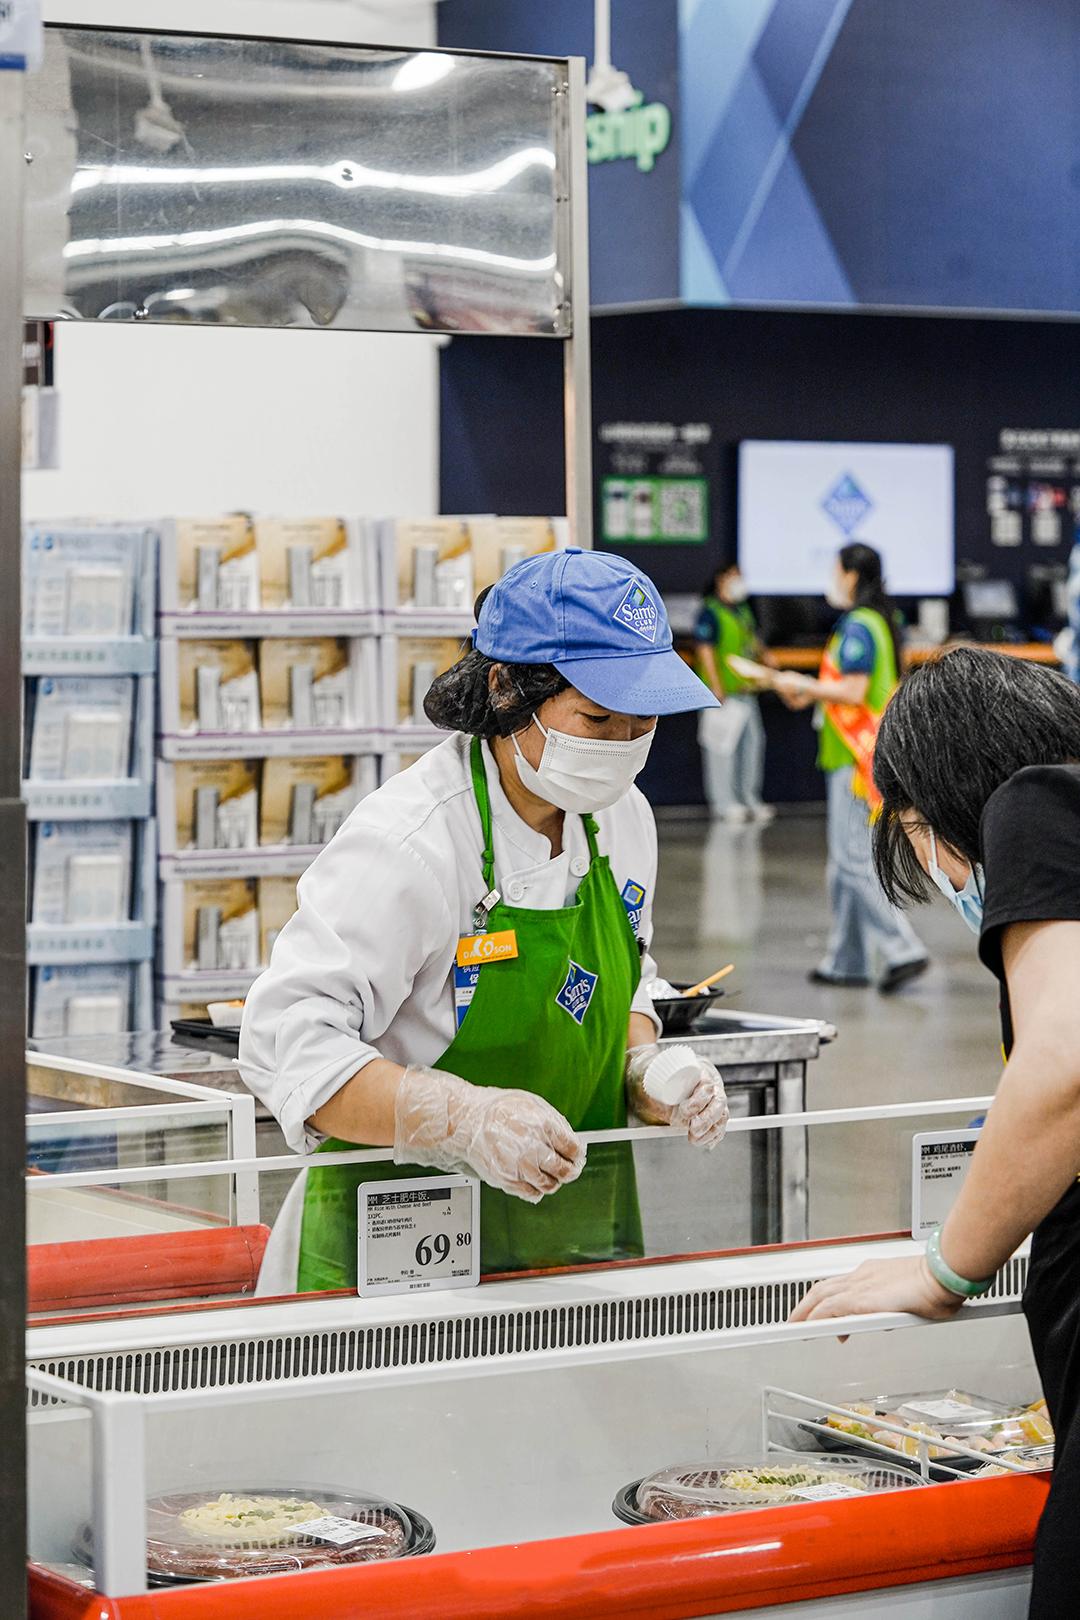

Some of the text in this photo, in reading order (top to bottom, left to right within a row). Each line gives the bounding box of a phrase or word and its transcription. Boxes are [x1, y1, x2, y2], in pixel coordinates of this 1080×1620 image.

[621, 603, 656, 622] Sam's
[564, 979, 590, 1006] Sam's
[456, 1232, 472, 1247] 80
